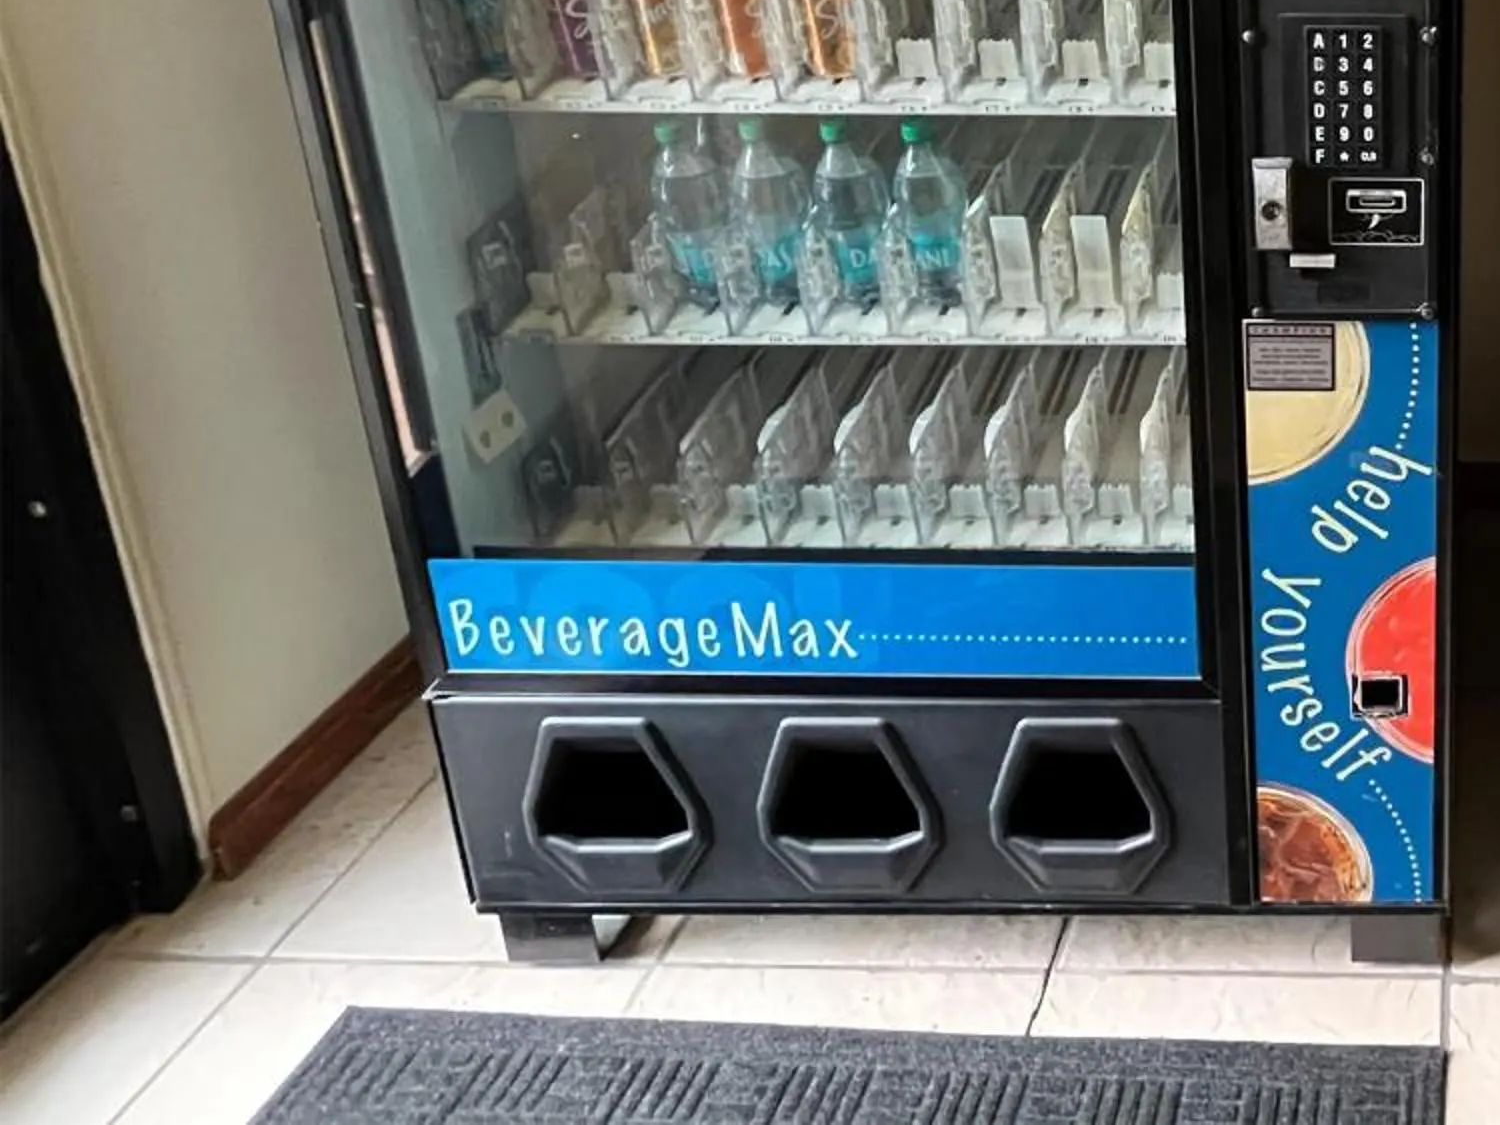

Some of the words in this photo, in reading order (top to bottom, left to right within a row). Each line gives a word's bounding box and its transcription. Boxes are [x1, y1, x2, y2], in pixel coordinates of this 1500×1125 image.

[1313, 33, 1325, 50] A
[1339, 33, 1348, 50] 1
[1363, 33, 1373, 50] 2
[1338, 57, 1349, 73] 3
[1363, 57, 1373, 73] 4
[1313, 81, 1325, 96] C
[1338, 81, 1349, 96] 5
[1363, 81, 1373, 96] 6
[1313, 103, 1325, 119] D
[1338, 103, 1349, 119] 7
[1363, 103, 1373, 119] 8
[1313, 127, 1325, 142] E
[1338, 127, 1349, 142] 9
[1363, 127, 1373, 142] 0
[1313, 149, 1325, 164] F
[1311, 446, 1433, 553] help
[1260, 567, 1393, 781] yourself
